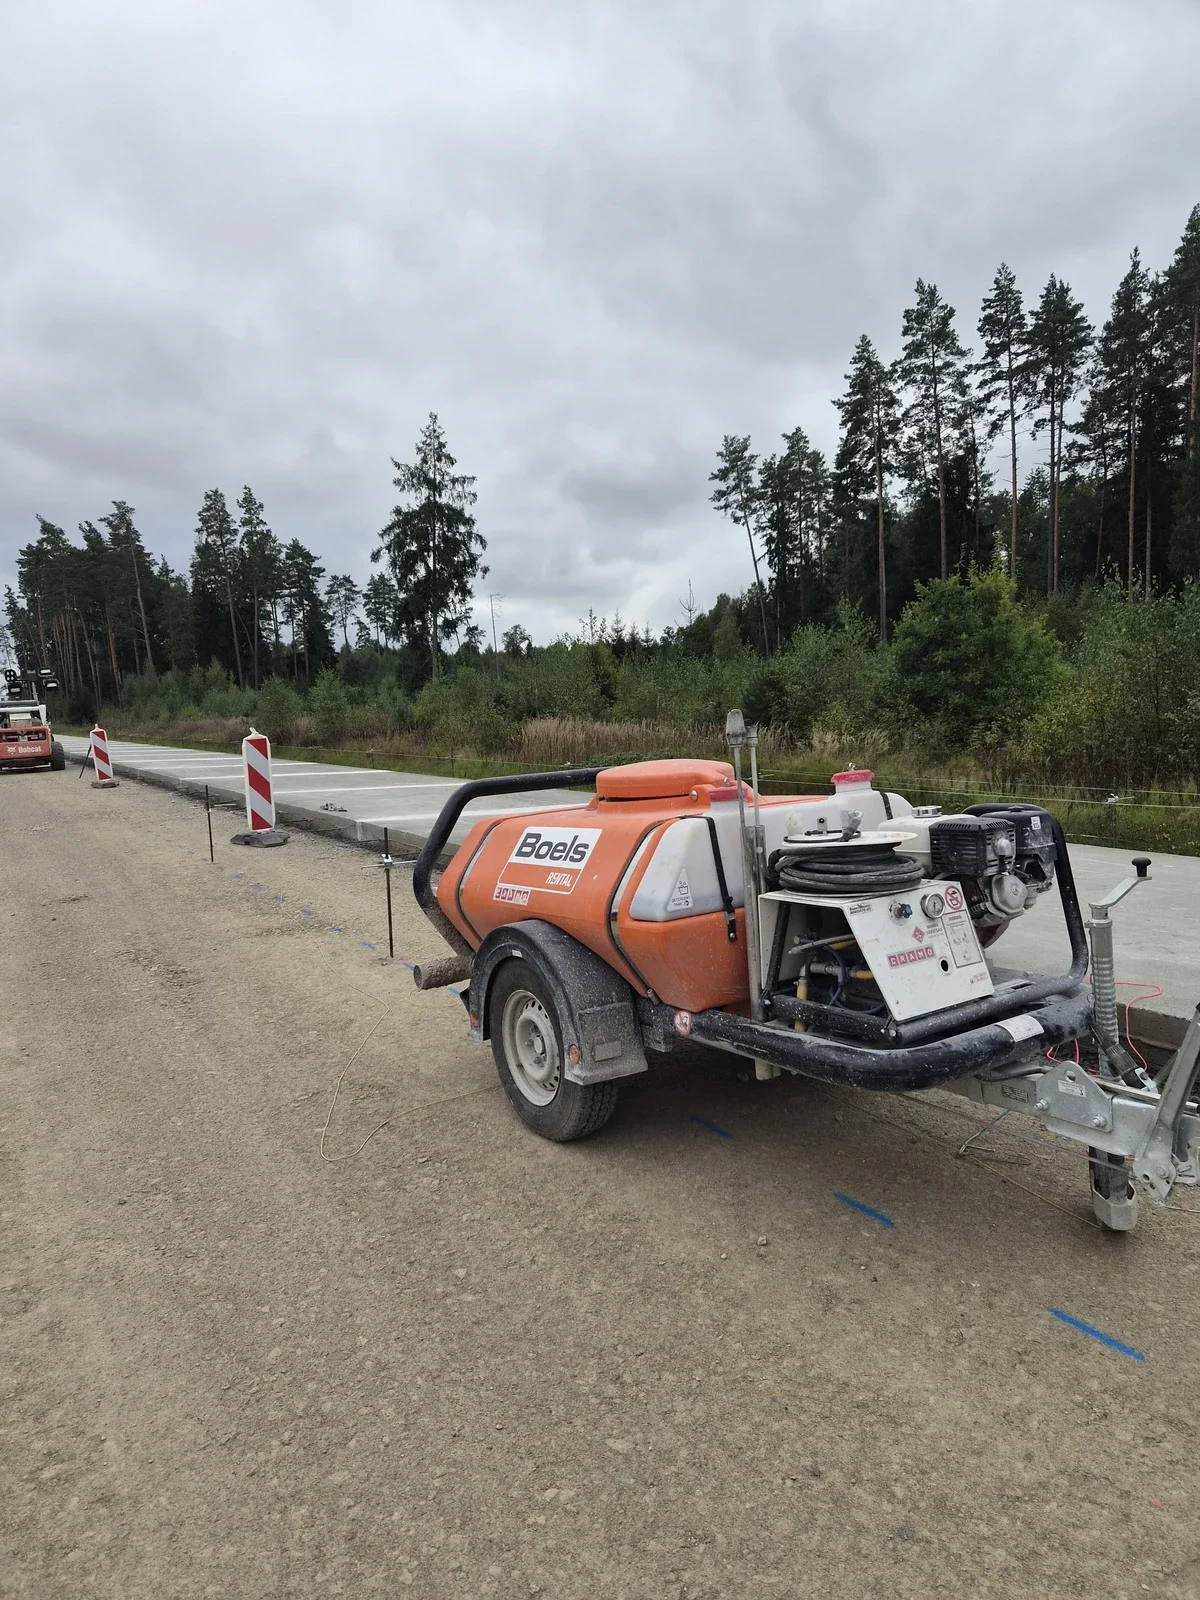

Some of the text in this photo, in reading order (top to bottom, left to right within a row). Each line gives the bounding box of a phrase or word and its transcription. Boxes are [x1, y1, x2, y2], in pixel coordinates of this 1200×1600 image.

[18, 745, 42, 753] Bobcat
[515, 832, 590, 863] Boels
[545, 872, 573, 887] RENTAL
[888, 946, 935, 967] CRAMO
